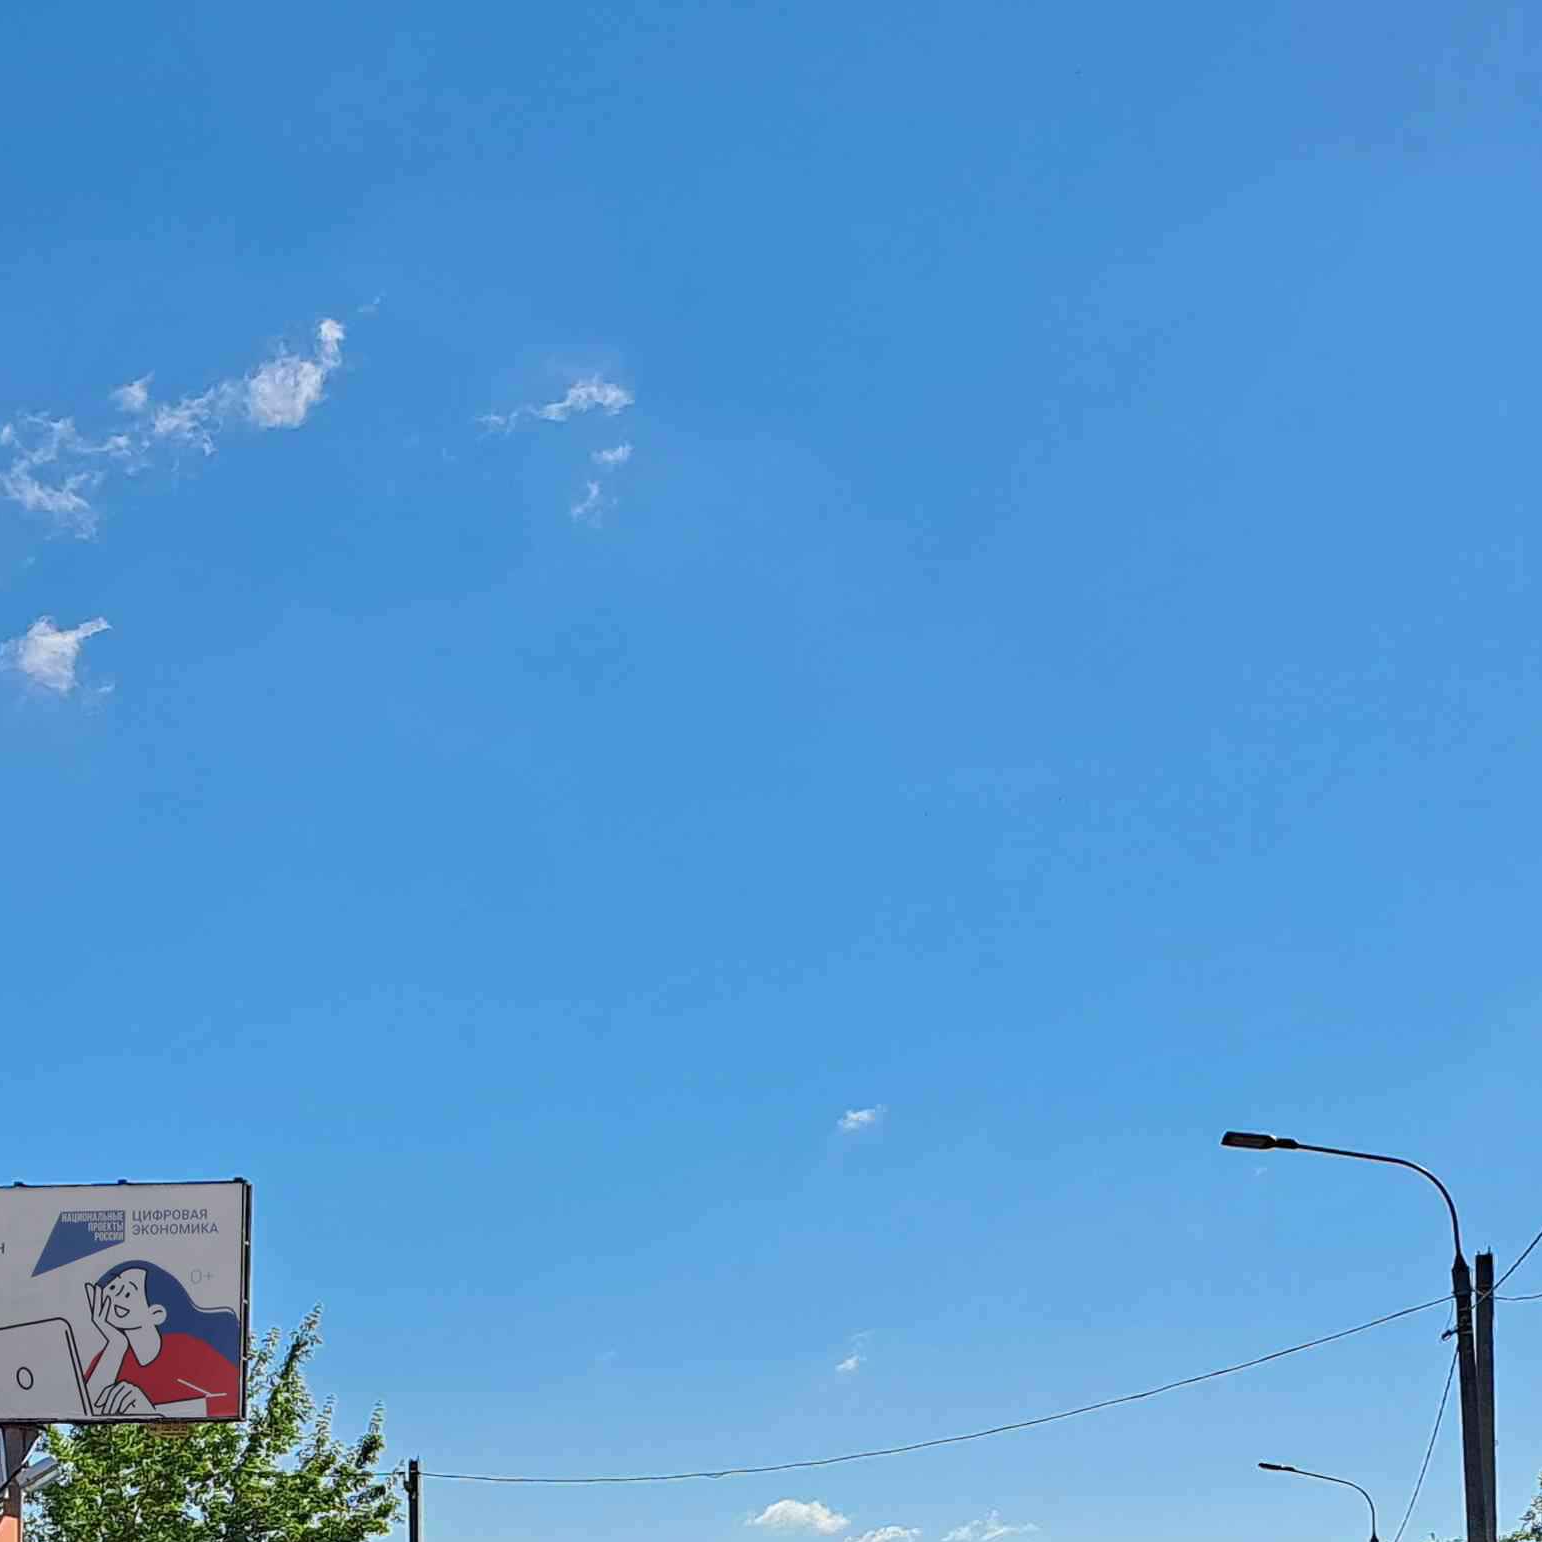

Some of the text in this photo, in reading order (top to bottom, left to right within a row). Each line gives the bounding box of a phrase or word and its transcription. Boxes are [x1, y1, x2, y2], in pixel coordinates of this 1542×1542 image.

[61, 1211, 124, 1222] НАЦИОНАЛЬНЫЕ
[132, 1209, 208, 1222] ЦИФРОВАЯ
[88, 1222, 124, 1232] ПРОЕКТЫ
[132, 1223, 219, 1235] ЭКОНОМИКА
[94, 1232, 124, 1241] РОССИИ
[190, 1269, 214, 1285] 0+
